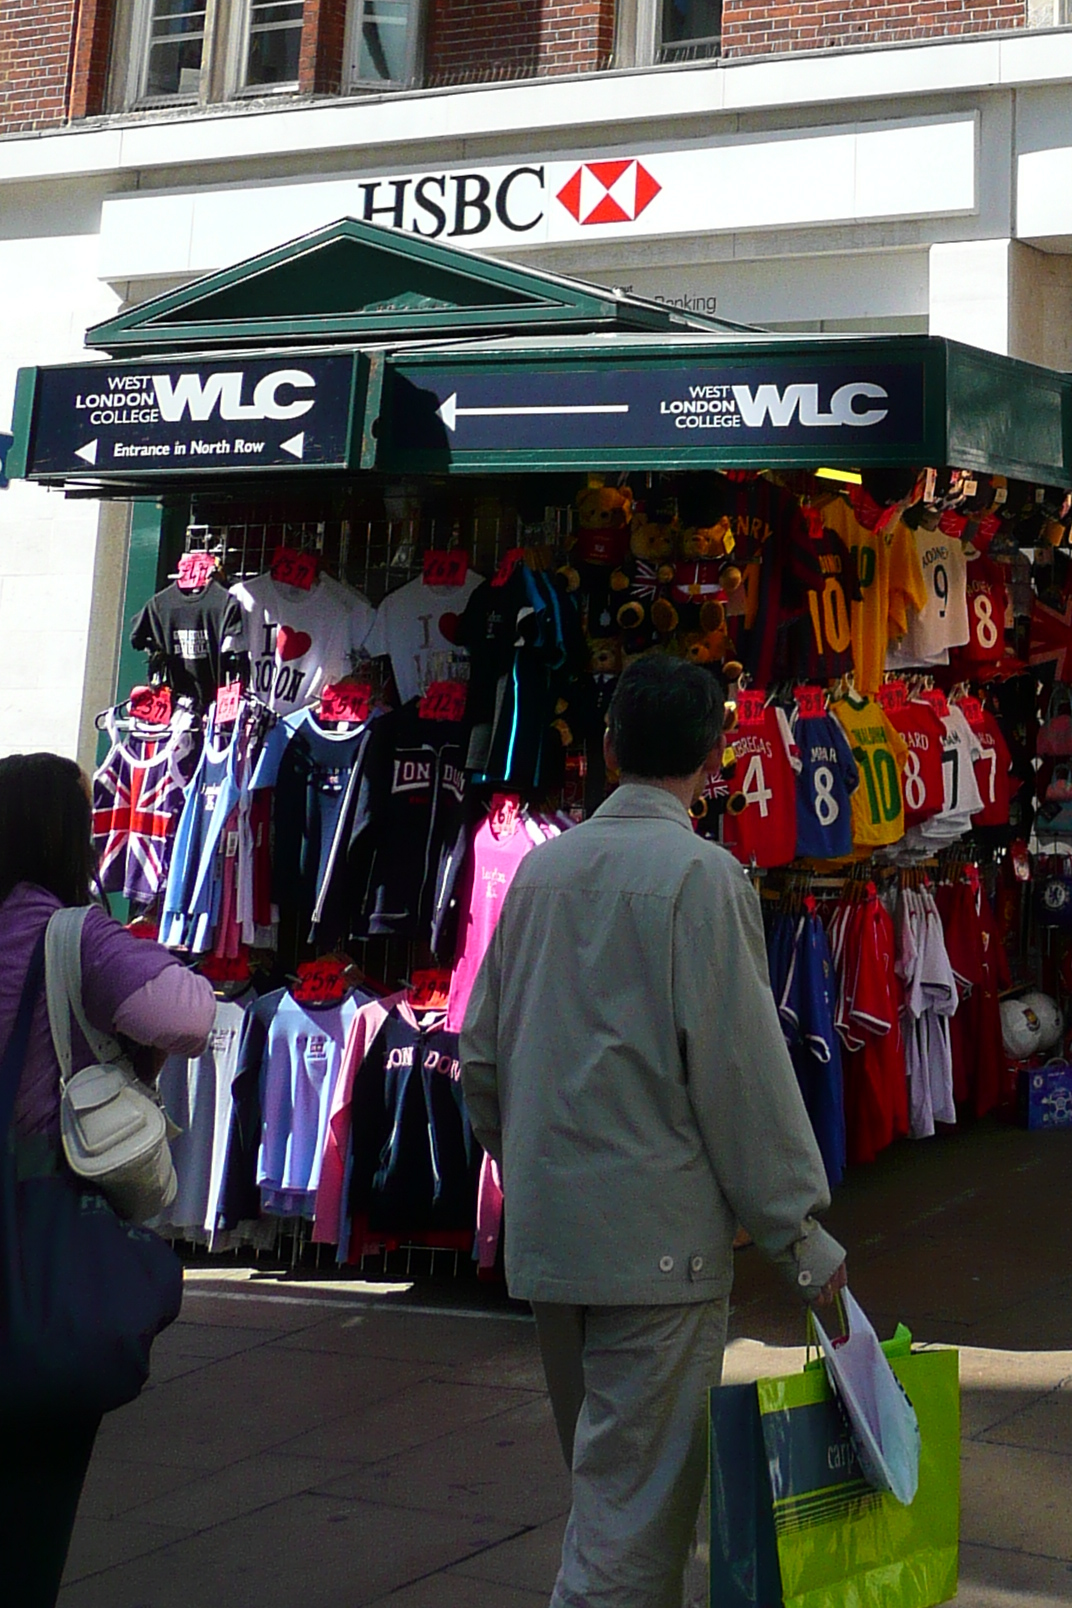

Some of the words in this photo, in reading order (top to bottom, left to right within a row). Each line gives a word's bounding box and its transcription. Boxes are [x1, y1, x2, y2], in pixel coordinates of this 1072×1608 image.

[358, 165, 546, 239] HSBC
[75, 392, 154, 409] LONDON
[108, 375, 152, 390] WEST
[152, 369, 316, 422] WLC
[660, 400, 736, 414] LONDON
[689, 385, 730, 399] WEST
[731, 382, 889, 427] WLC
[90, 410, 160, 425] COLLEGE
[674, 414, 741, 429] COLLEGE
[113, 443, 171, 458] Entrance
[174, 442, 187, 455] in
[190, 440, 231, 456] North
[233, 439, 266, 454] Row
[807, 577, 851, 654] 10
[933, 564, 948, 618] 9
[261, 623, 277, 657] I
[974, 594, 999, 649] 8
[391, 759, 430, 795] LON
[742, 754, 773, 819] 4
[813, 766, 840, 826] 8
[861, 748, 901, 825] 10
[904, 749, 926, 810] 8
[942, 749, 958, 810] 7
[980, 747, 997, 804] 7
